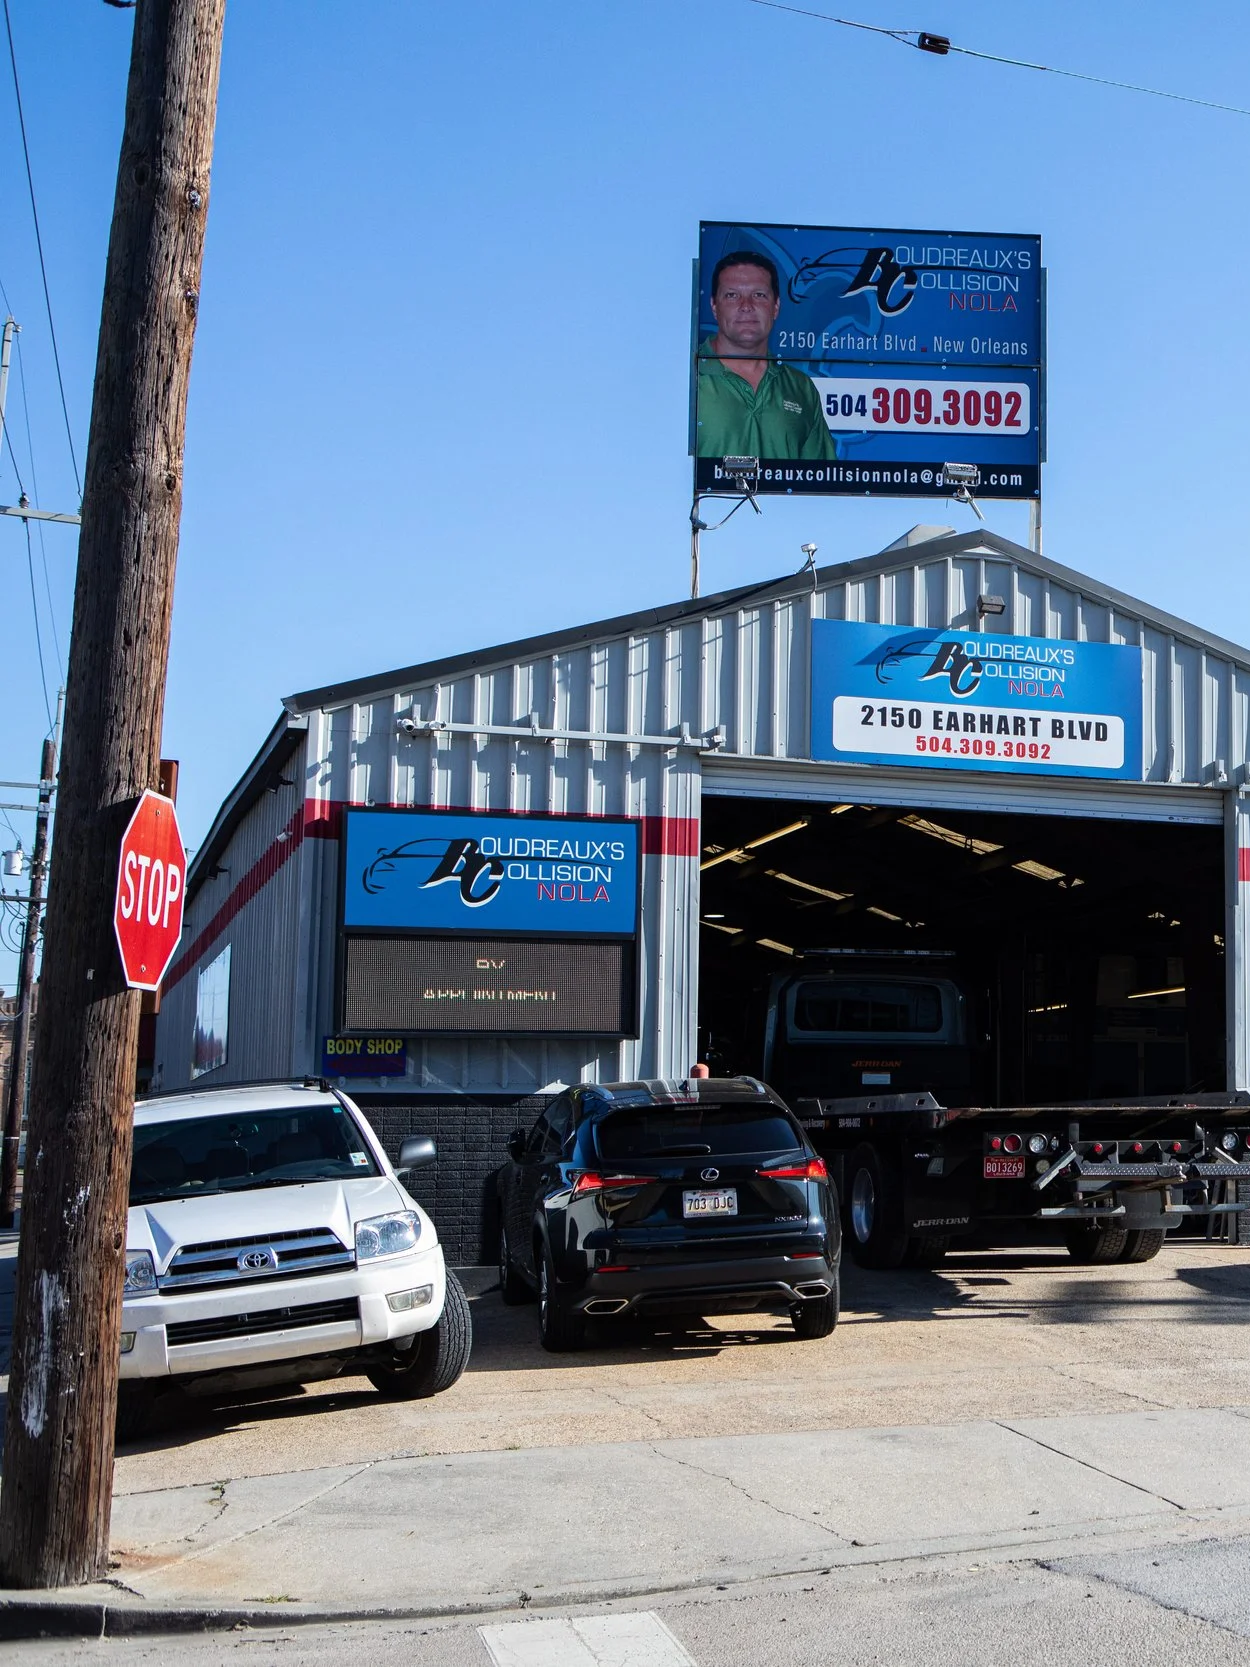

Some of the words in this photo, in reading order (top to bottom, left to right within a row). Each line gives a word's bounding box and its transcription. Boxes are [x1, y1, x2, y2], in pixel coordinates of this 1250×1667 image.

[949, 292, 1019, 313] NOLA
[779, 331, 816, 349] 2150
[822, 332, 878, 351] Earhart
[884, 334, 917, 352] Blvd
[933, 336, 965, 354] New
[971, 337, 1029, 356] Orleans
[826, 393, 867, 418] 504
[872, 386, 1022, 428] 309.3092
[1007, 679, 1065, 699] NOLA
[860, 704, 922, 730] 2150
[932, 710, 1041, 738] EARHART
[1051, 717, 1109, 742] BLVD
[915, 735, 1051, 760] 504.309.3092
[121, 850, 181, 928] STOP
[537, 882, 611, 903] NOLA
[326, 1038, 363, 1055] BODY
[367, 1038, 404, 1055] SHOP
[687, 1197, 707, 1211] 703
[713, 1196, 734, 1210] DJC
